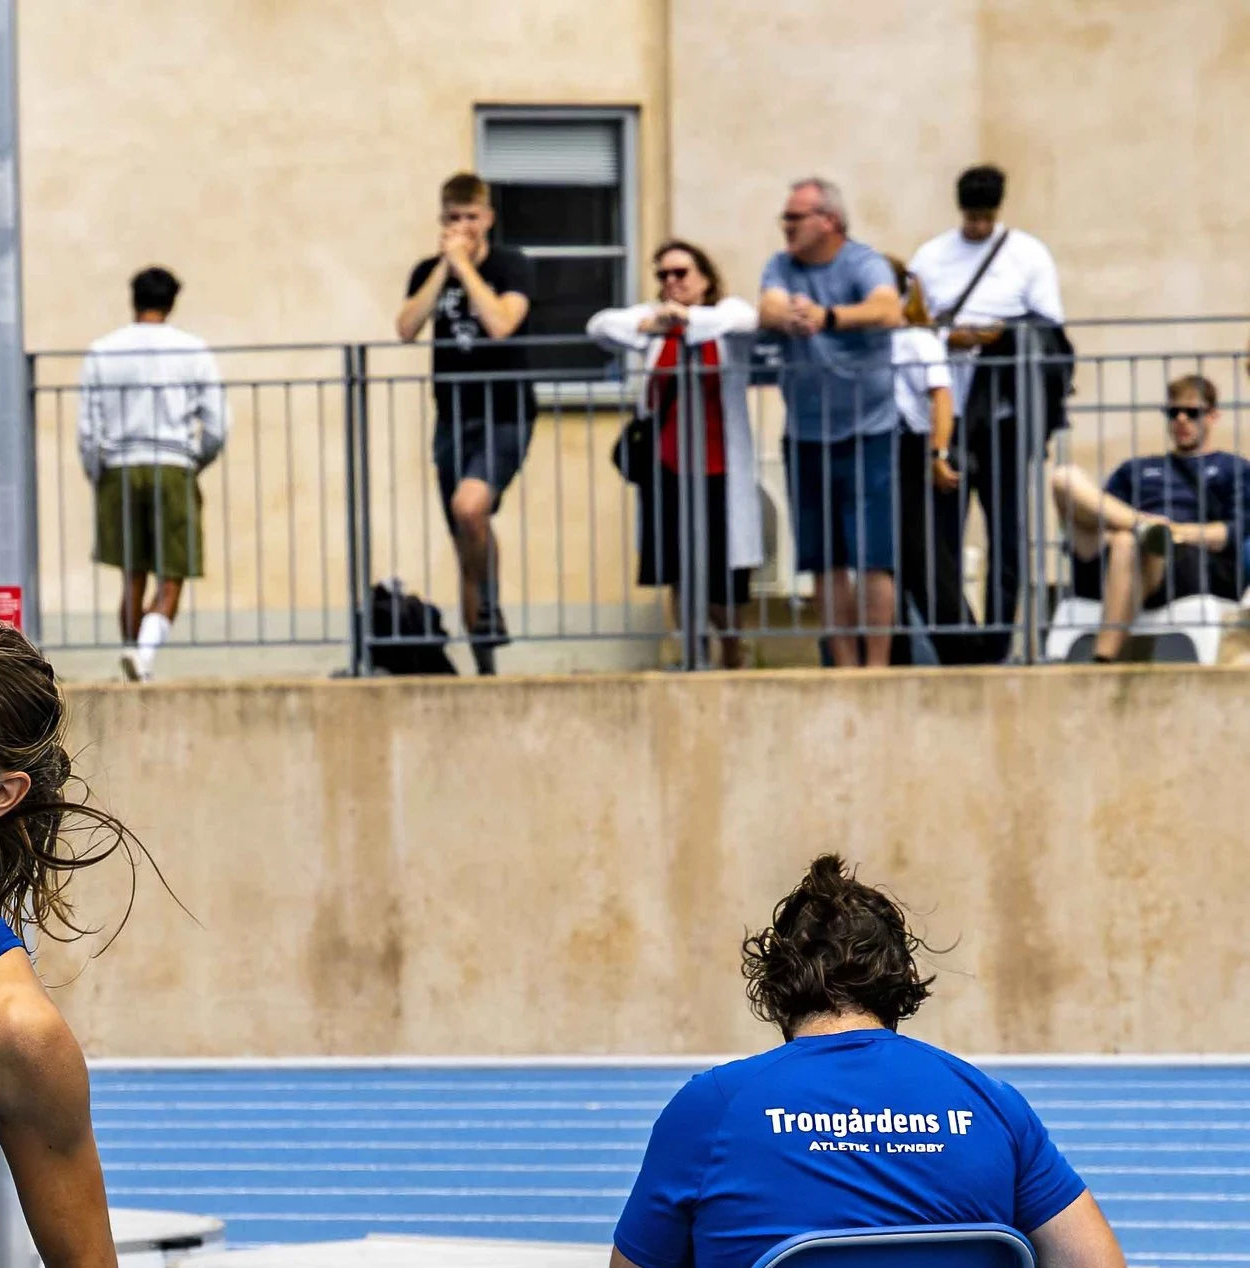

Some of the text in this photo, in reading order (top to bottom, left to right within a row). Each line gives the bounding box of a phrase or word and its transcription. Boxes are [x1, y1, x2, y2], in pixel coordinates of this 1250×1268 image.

[765, 1108, 973, 1138] Trongårdens IF
[809, 1141, 870, 1153] ATLETIK
[886, 1142, 944, 1153] LYNGBY
